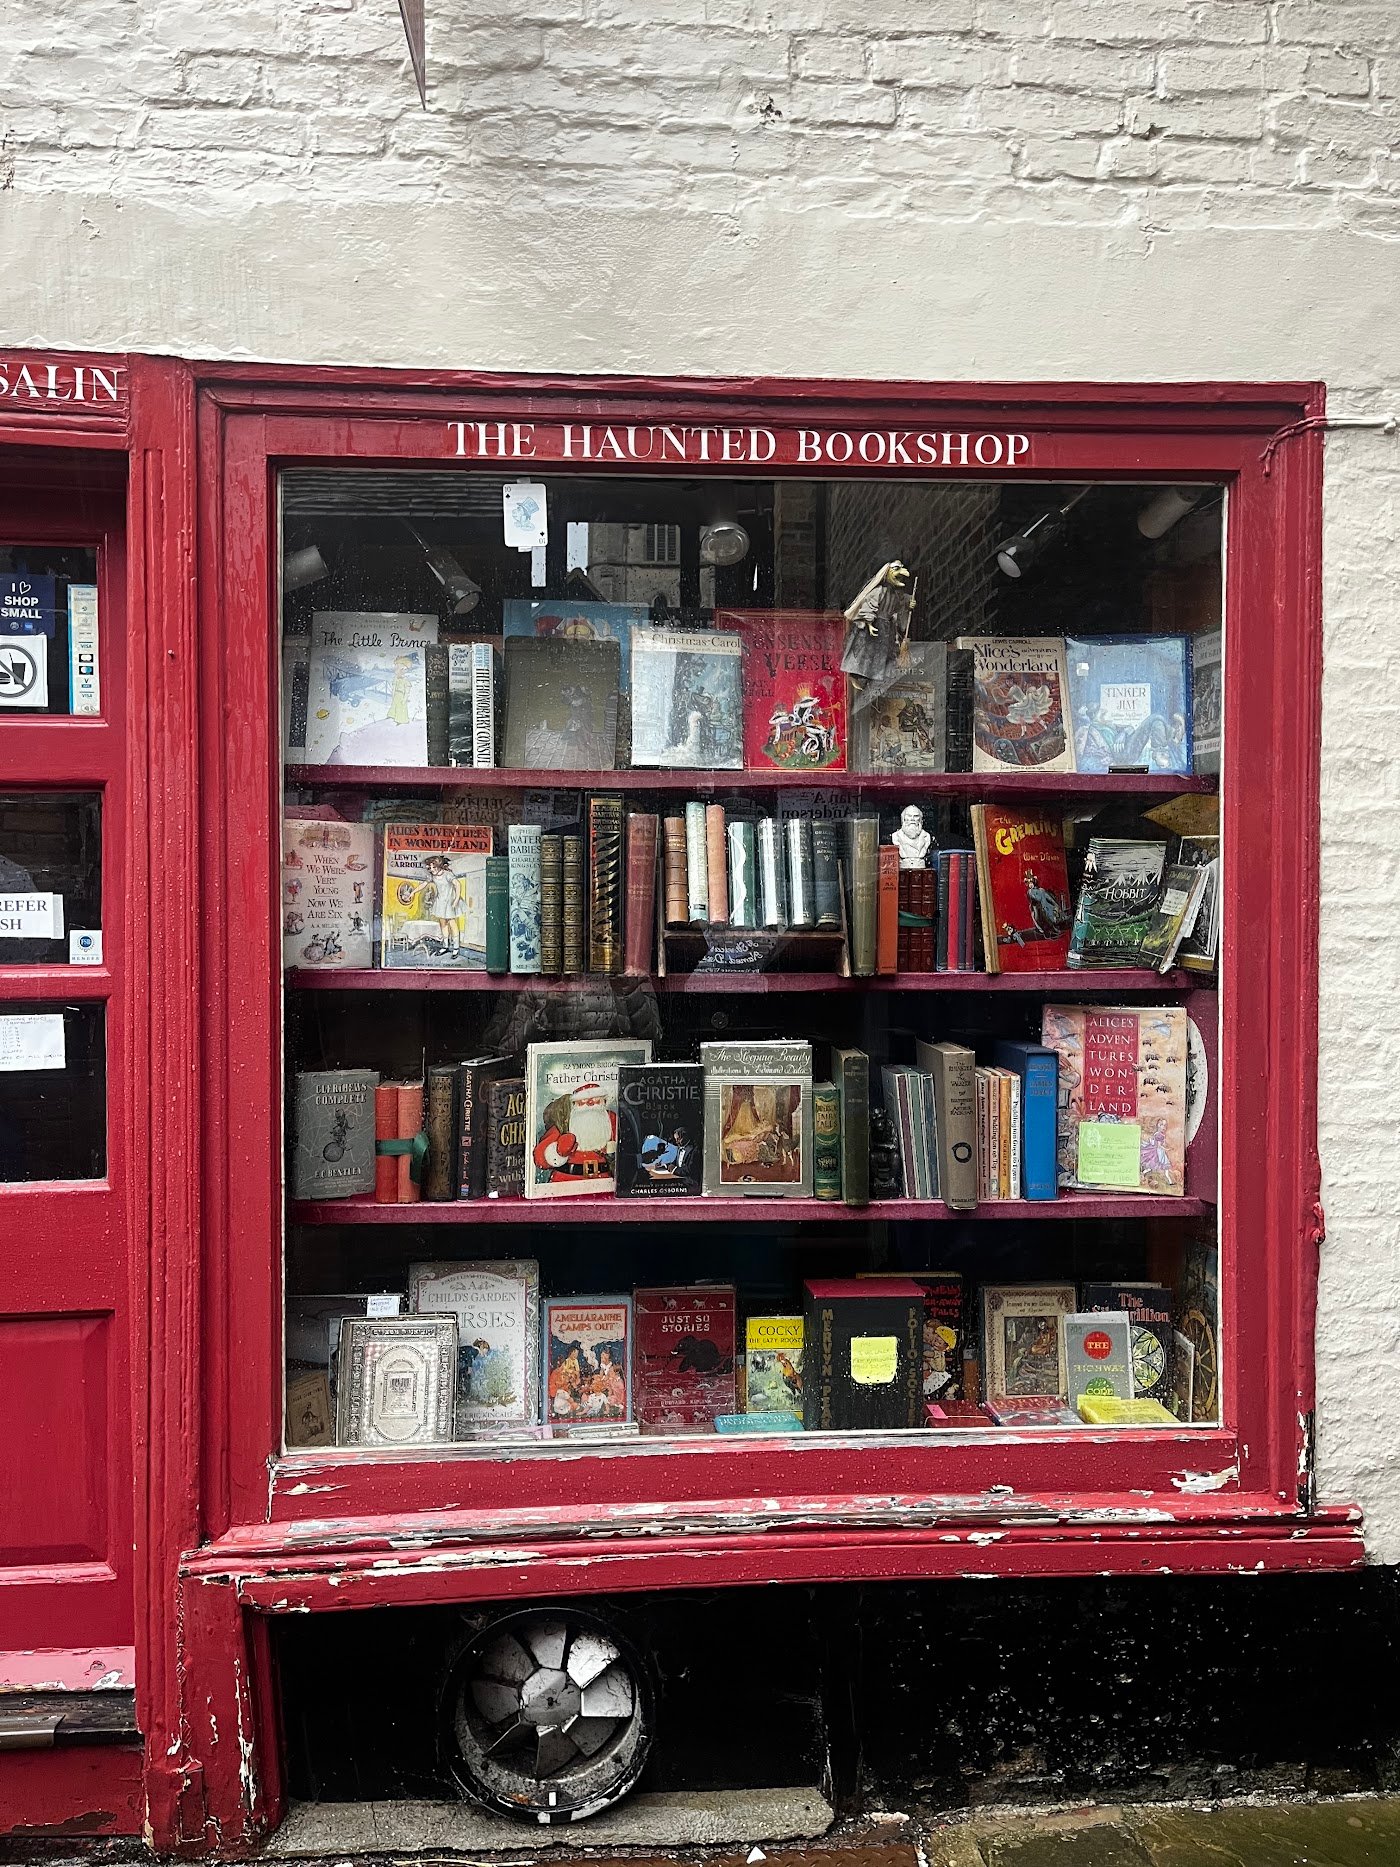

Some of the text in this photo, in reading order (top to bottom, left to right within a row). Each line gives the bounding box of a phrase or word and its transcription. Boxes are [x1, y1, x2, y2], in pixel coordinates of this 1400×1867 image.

[447, 422, 1029, 465] THE HAUNTED BOOKSHOP
[4, 596, 39, 607] SHOP
[1, 608, 42, 619] SMALL
[321, 631, 343, 646] The
[349, 631, 382, 648] Little
[711, 636, 742, 648] Carol
[973, 644, 1020, 658] Alice's
[764, 654, 832, 677] VERSE
[974, 659, 1058, 672] Wonderland
[1105, 687, 1146, 698] TINKER
[476, 685, 491, 729] HONORARY
[1117, 700, 1136, 710] JIM
[422, 827, 489, 838] ADVENTURES
[995, 821, 1057, 855] GREMLINS
[389, 839, 488, 850] IN WONDERLAND
[510, 835, 541, 845] WATER
[510, 846, 541, 854] BABIES
[314, 855, 340, 864] WHEN
[306, 865, 346, 874] WE WERE
[316, 876, 337, 884] VERY
[314, 886, 339, 894] YOUNG
[1106, 888, 1147, 900] HOBBIT
[0, 900, 47, 912] REFER
[307, 899, 343, 908] NOW WE
[307, 909, 343, 918] ARE SIX
[1091, 1017, 1134, 1028] ALICE'S
[1089, 1034, 1134, 1044] ADVEN-
[1089, 1051, 1134, 1062] TURES
[563, 1062, 599, 1070] RAYMOND
[545, 1072, 581, 1084] Father
[640, 1076, 687, 1085] AGATHA
[624, 1083, 700, 1105] CHRISTIE
[315, 1095, 367, 1106] COMPLETE
[1090, 1102, 1132, 1112] LAND
[471, 1292, 516, 1302] GARDEN
[460, 1312, 515, 1328] RSES
[661, 1315, 710, 1323] JUST SO
[559, 1323, 615, 1331] CAMPS OUT
[661, 1324, 710, 1332] STORIES
[758, 1326, 800, 1336] COCKY
